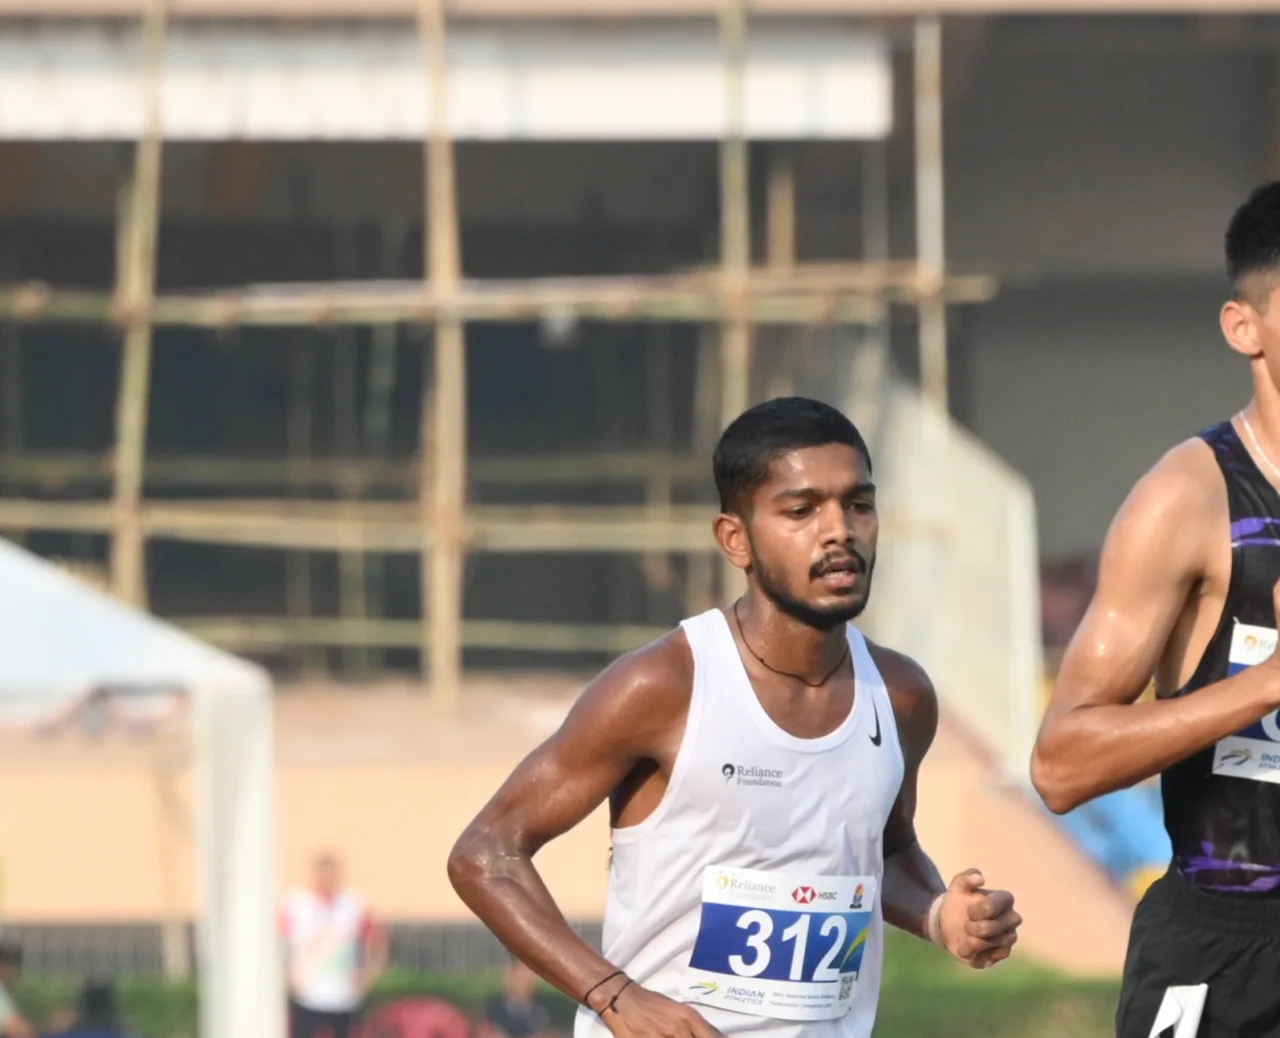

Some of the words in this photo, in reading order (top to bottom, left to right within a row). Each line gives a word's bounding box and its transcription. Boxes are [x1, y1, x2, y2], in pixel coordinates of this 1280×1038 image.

[736, 765, 784, 778] Reliance
[730, 878, 776, 893] Reliance
[818, 891, 838, 900] HSBC
[728, 909, 848, 982] 312
[726, 986, 766, 999] INDIAN
